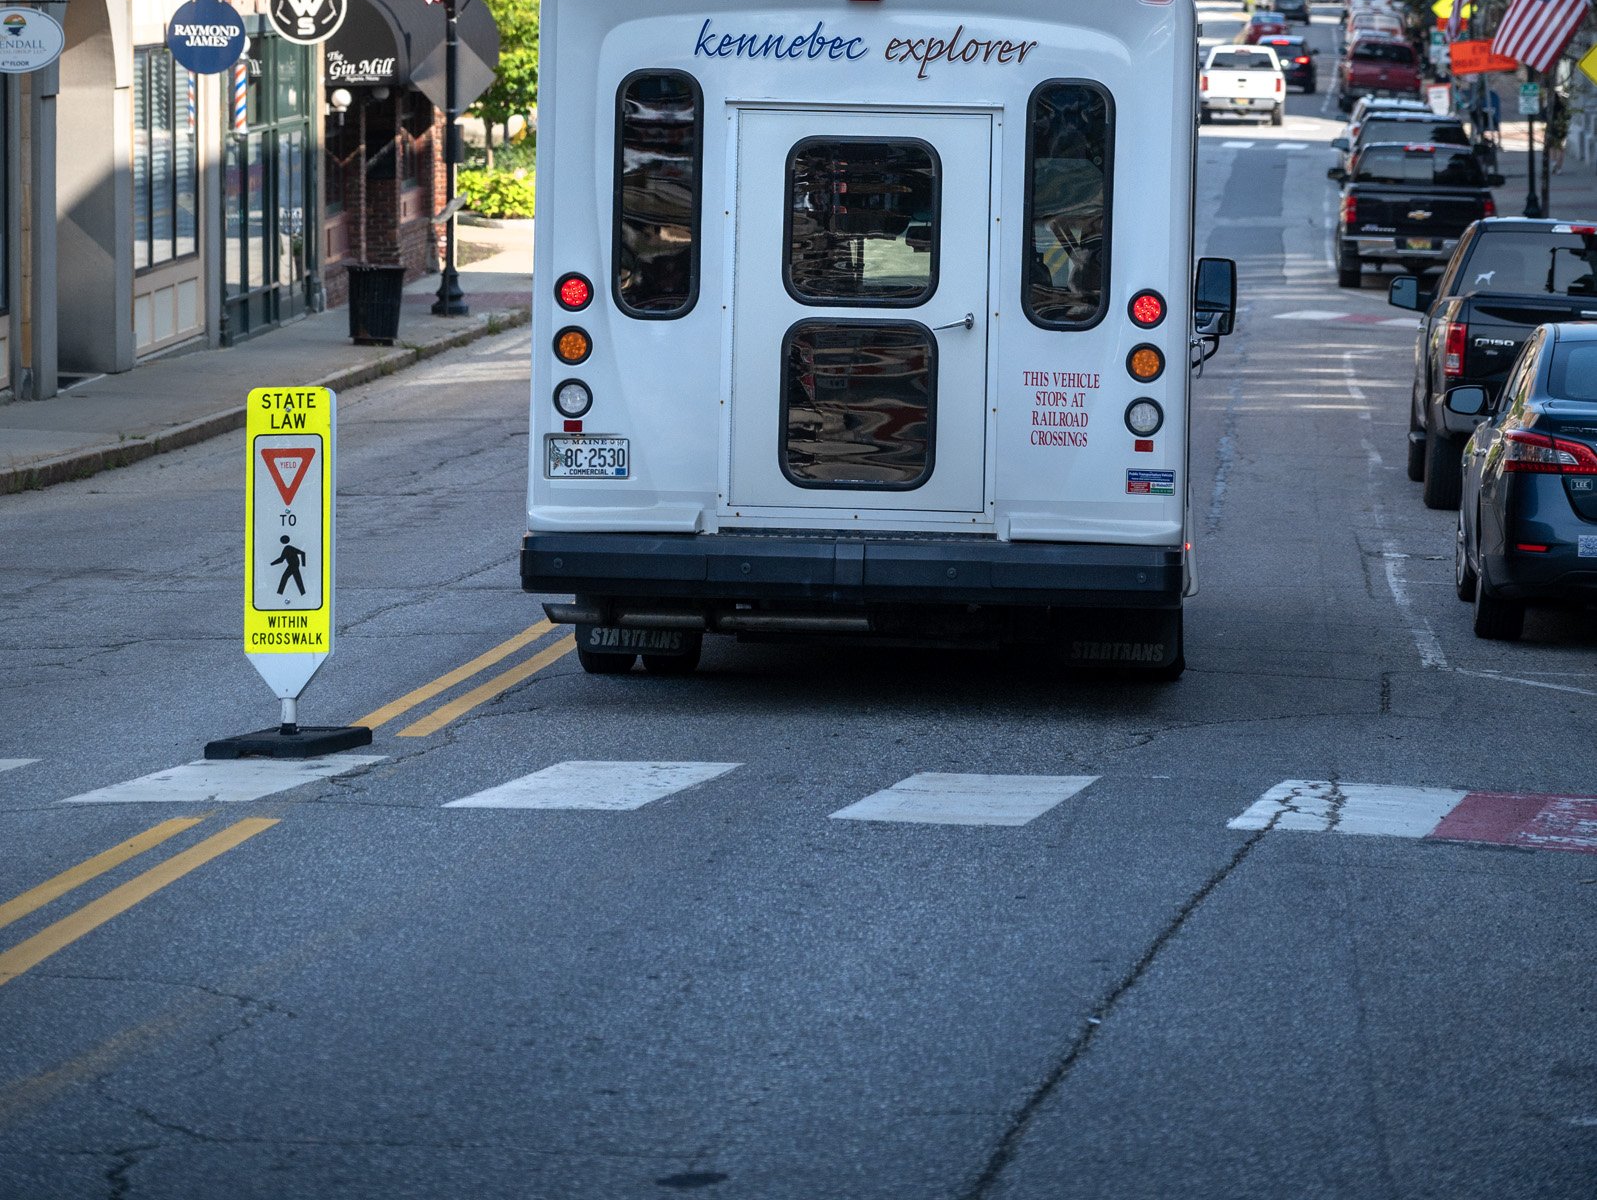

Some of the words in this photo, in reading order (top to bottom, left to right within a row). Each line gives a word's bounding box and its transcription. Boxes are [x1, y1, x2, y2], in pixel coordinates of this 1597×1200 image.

[174, 24, 240, 37] RAYMOND
[0, 39, 42, 49] ENDALL
[185, 35, 229, 47] JAMES
[327, 50, 344, 61] The
[694, 18, 869, 60] kennebec
[884, 24, 1039, 80] explorer
[329, 60, 356, 80] Gin
[358, 57, 396, 75] Mill
[1022, 371, 1050, 387] THIS
[1053, 372, 1100, 389] VEHICLE
[261, 393, 316, 409] STATE
[1035, 390, 1068, 407] STOPS
[1071, 392, 1086, 408] AT
[270, 413, 306, 429] LAW
[1031, 410, 1089, 428] RAILROAD
[1030, 429, 1088, 448] CROSSINGS
[279, 461, 297, 469] YIELD
[569, 468, 609, 476] COMMERCIAL
[280, 514, 297, 527] TO
[267, 616, 308, 628] WITHIN
[252, 632, 323, 645] CROSSWALK
